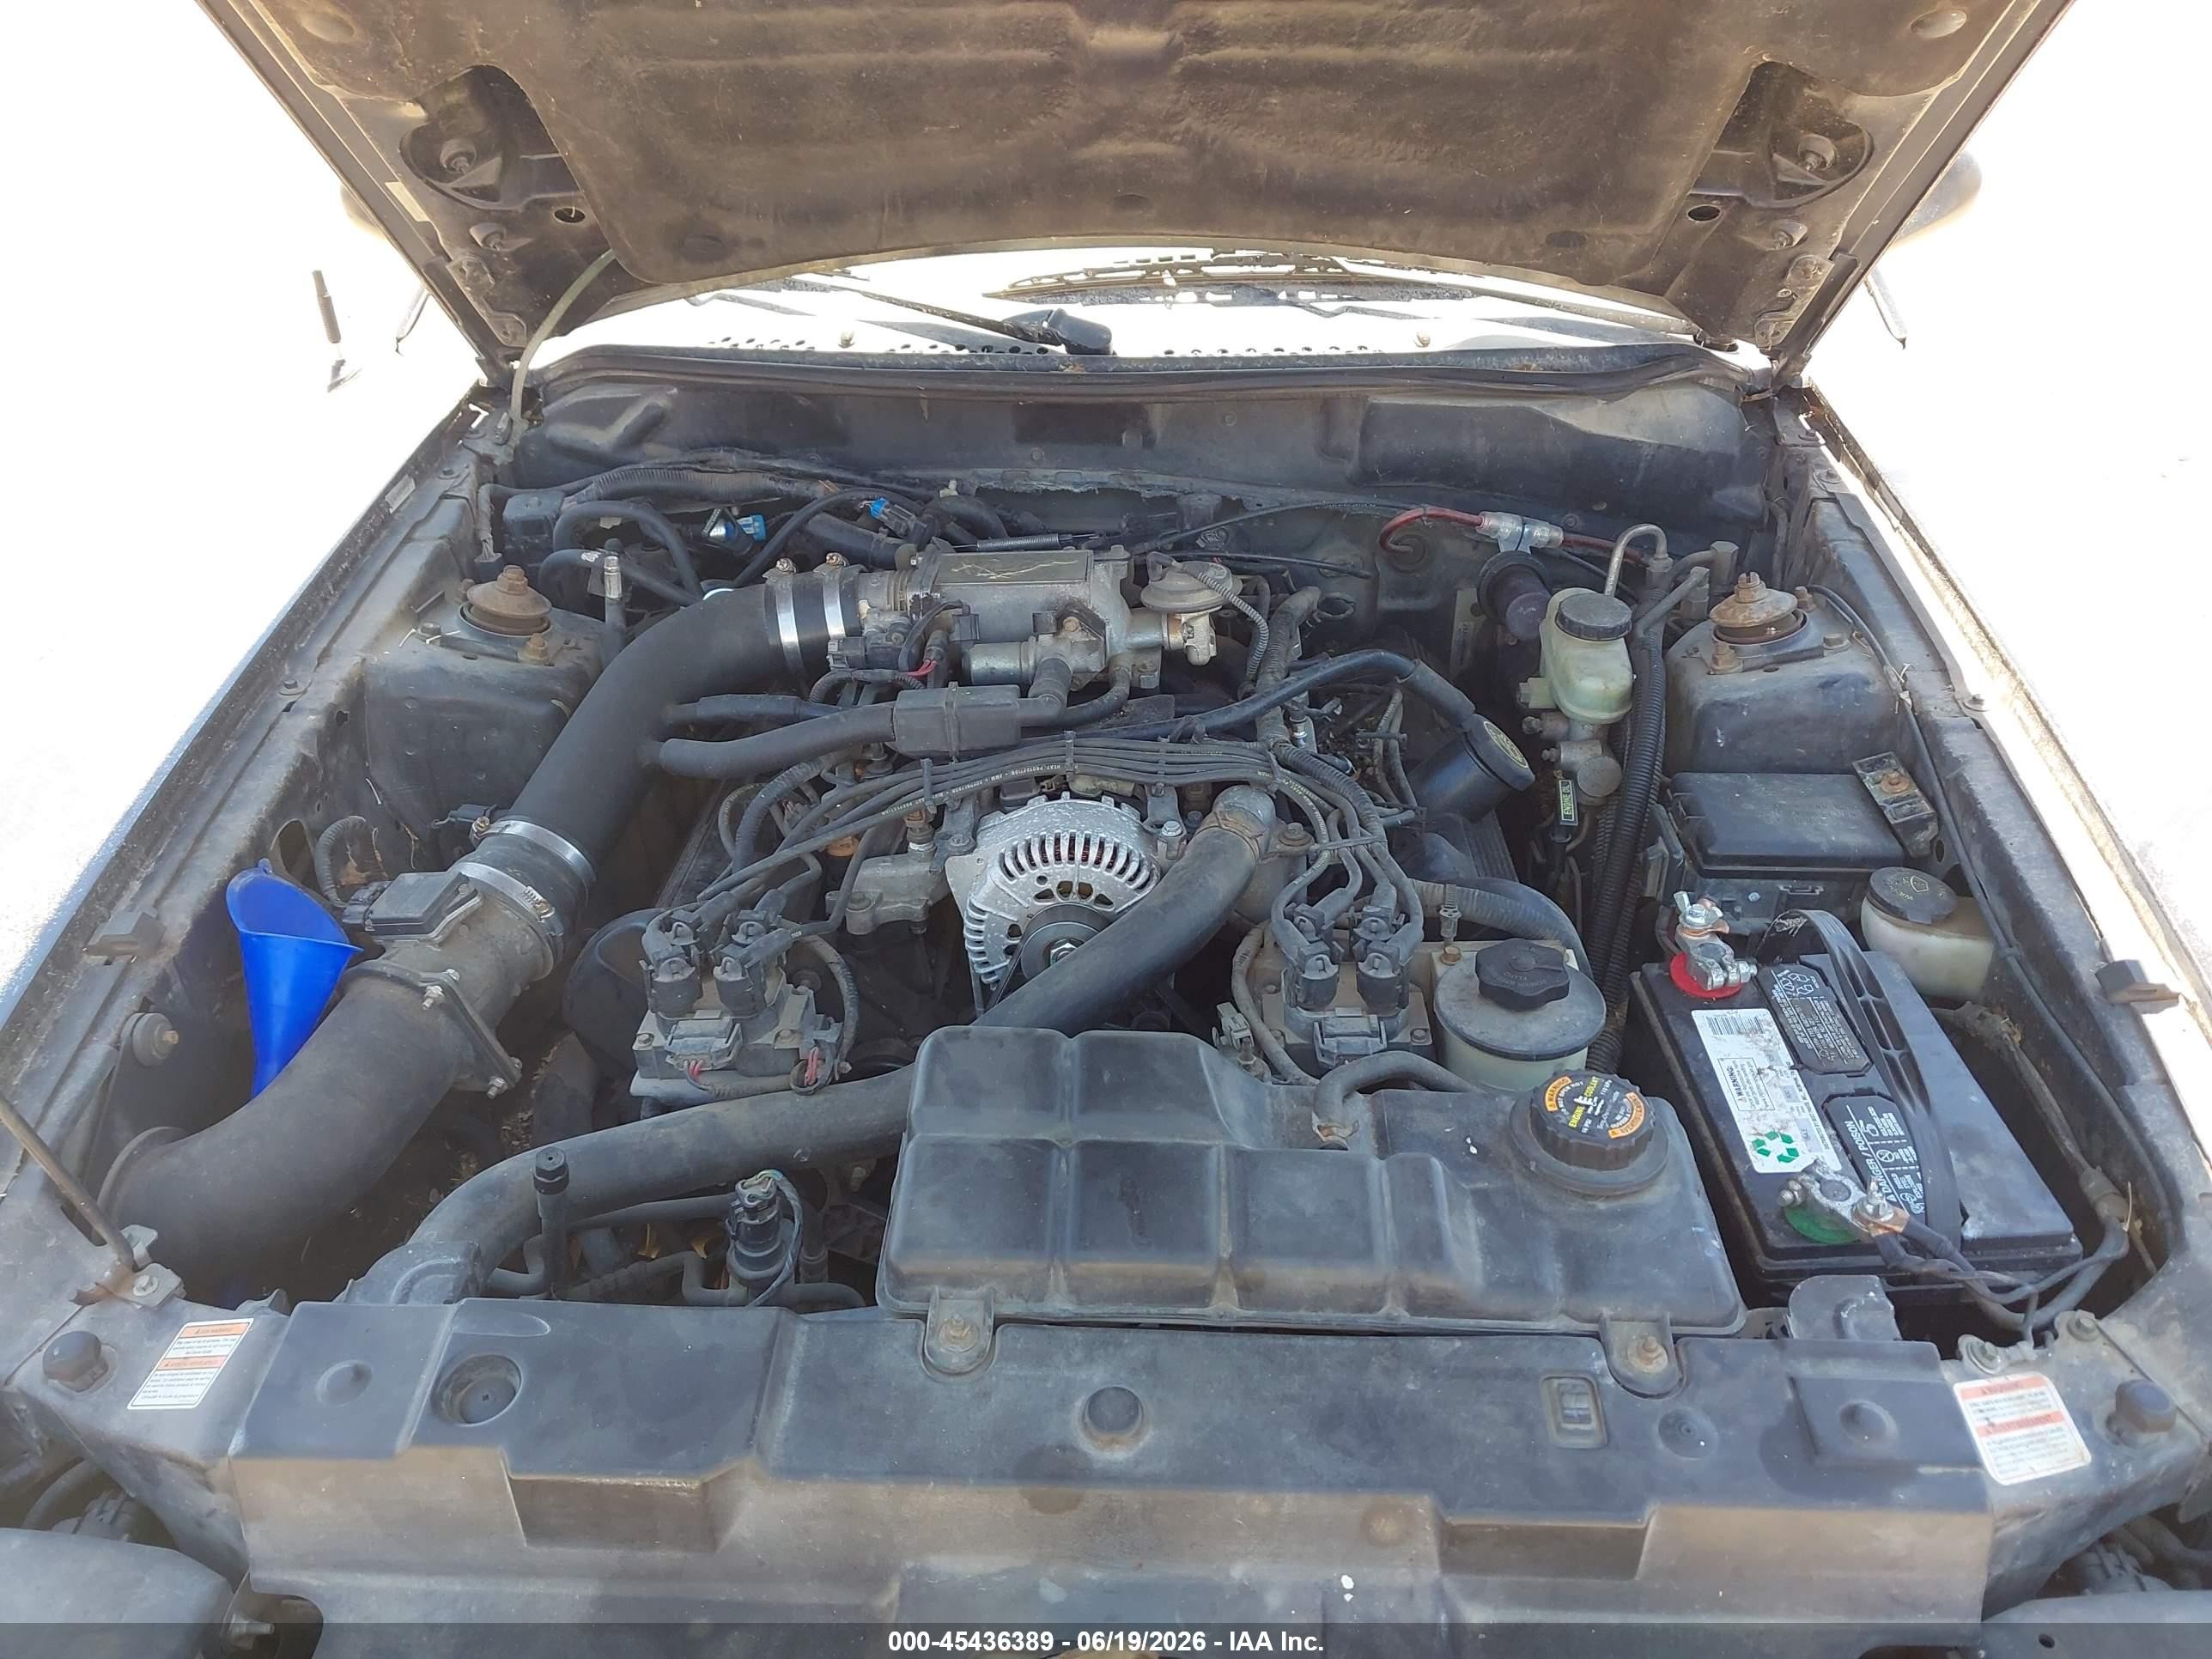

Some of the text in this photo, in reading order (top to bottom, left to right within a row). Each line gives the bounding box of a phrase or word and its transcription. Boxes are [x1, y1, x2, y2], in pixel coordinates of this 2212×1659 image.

[1563, 794, 1571, 815] ENGINE
[1725, 1065, 1744, 1097] WARNING:
[1569, 1105, 1586, 1129] ENGINE
[1584, 1075, 1602, 1098] COOLANT
[1844, 1120, 1868, 1150] POISON
[1865, 1158, 1892, 1193] DANGER
